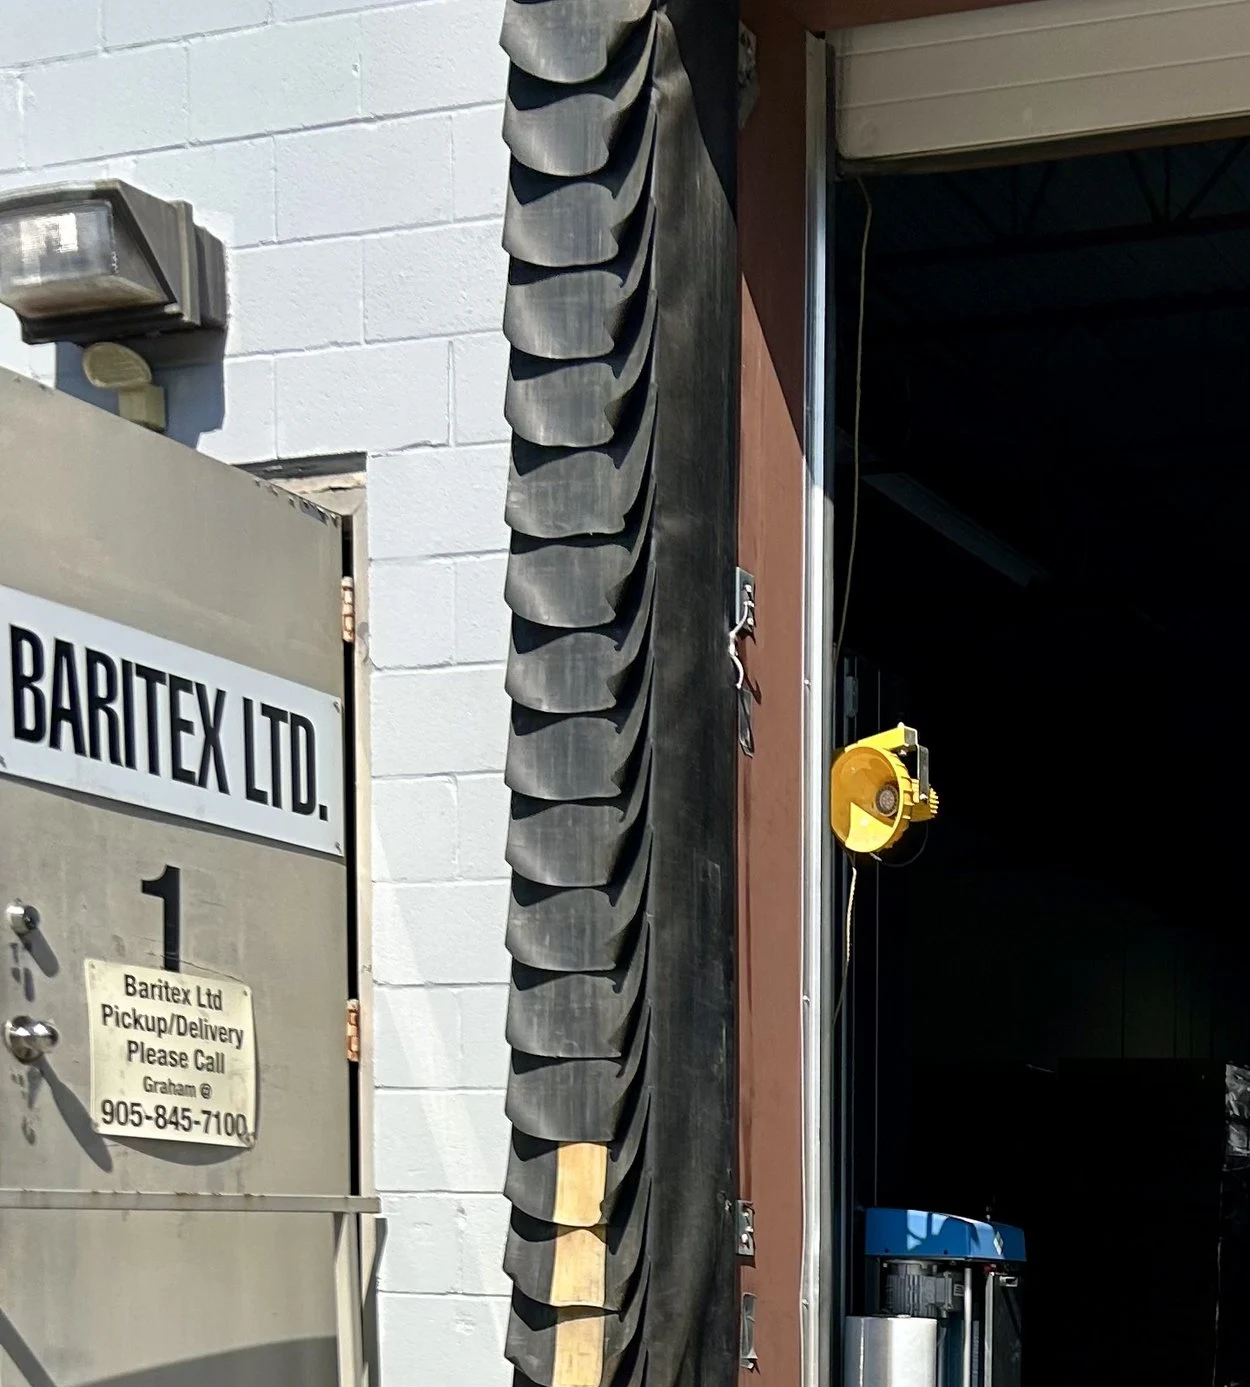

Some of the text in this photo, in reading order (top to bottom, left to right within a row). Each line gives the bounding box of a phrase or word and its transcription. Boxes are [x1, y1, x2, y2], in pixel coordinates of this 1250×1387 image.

[9, 623, 329, 822] BARITEX LTD.
[141, 864, 181, 973] 1
[123, 973, 223, 1012] Baritex Ltd
[101, 1003, 244, 1050] Pickup/Delivery
[126, 1039, 226, 1075] Please Call
[143, 1076, 213, 1100] Graham @
[101, 1099, 248, 1138] 905-845-7100
